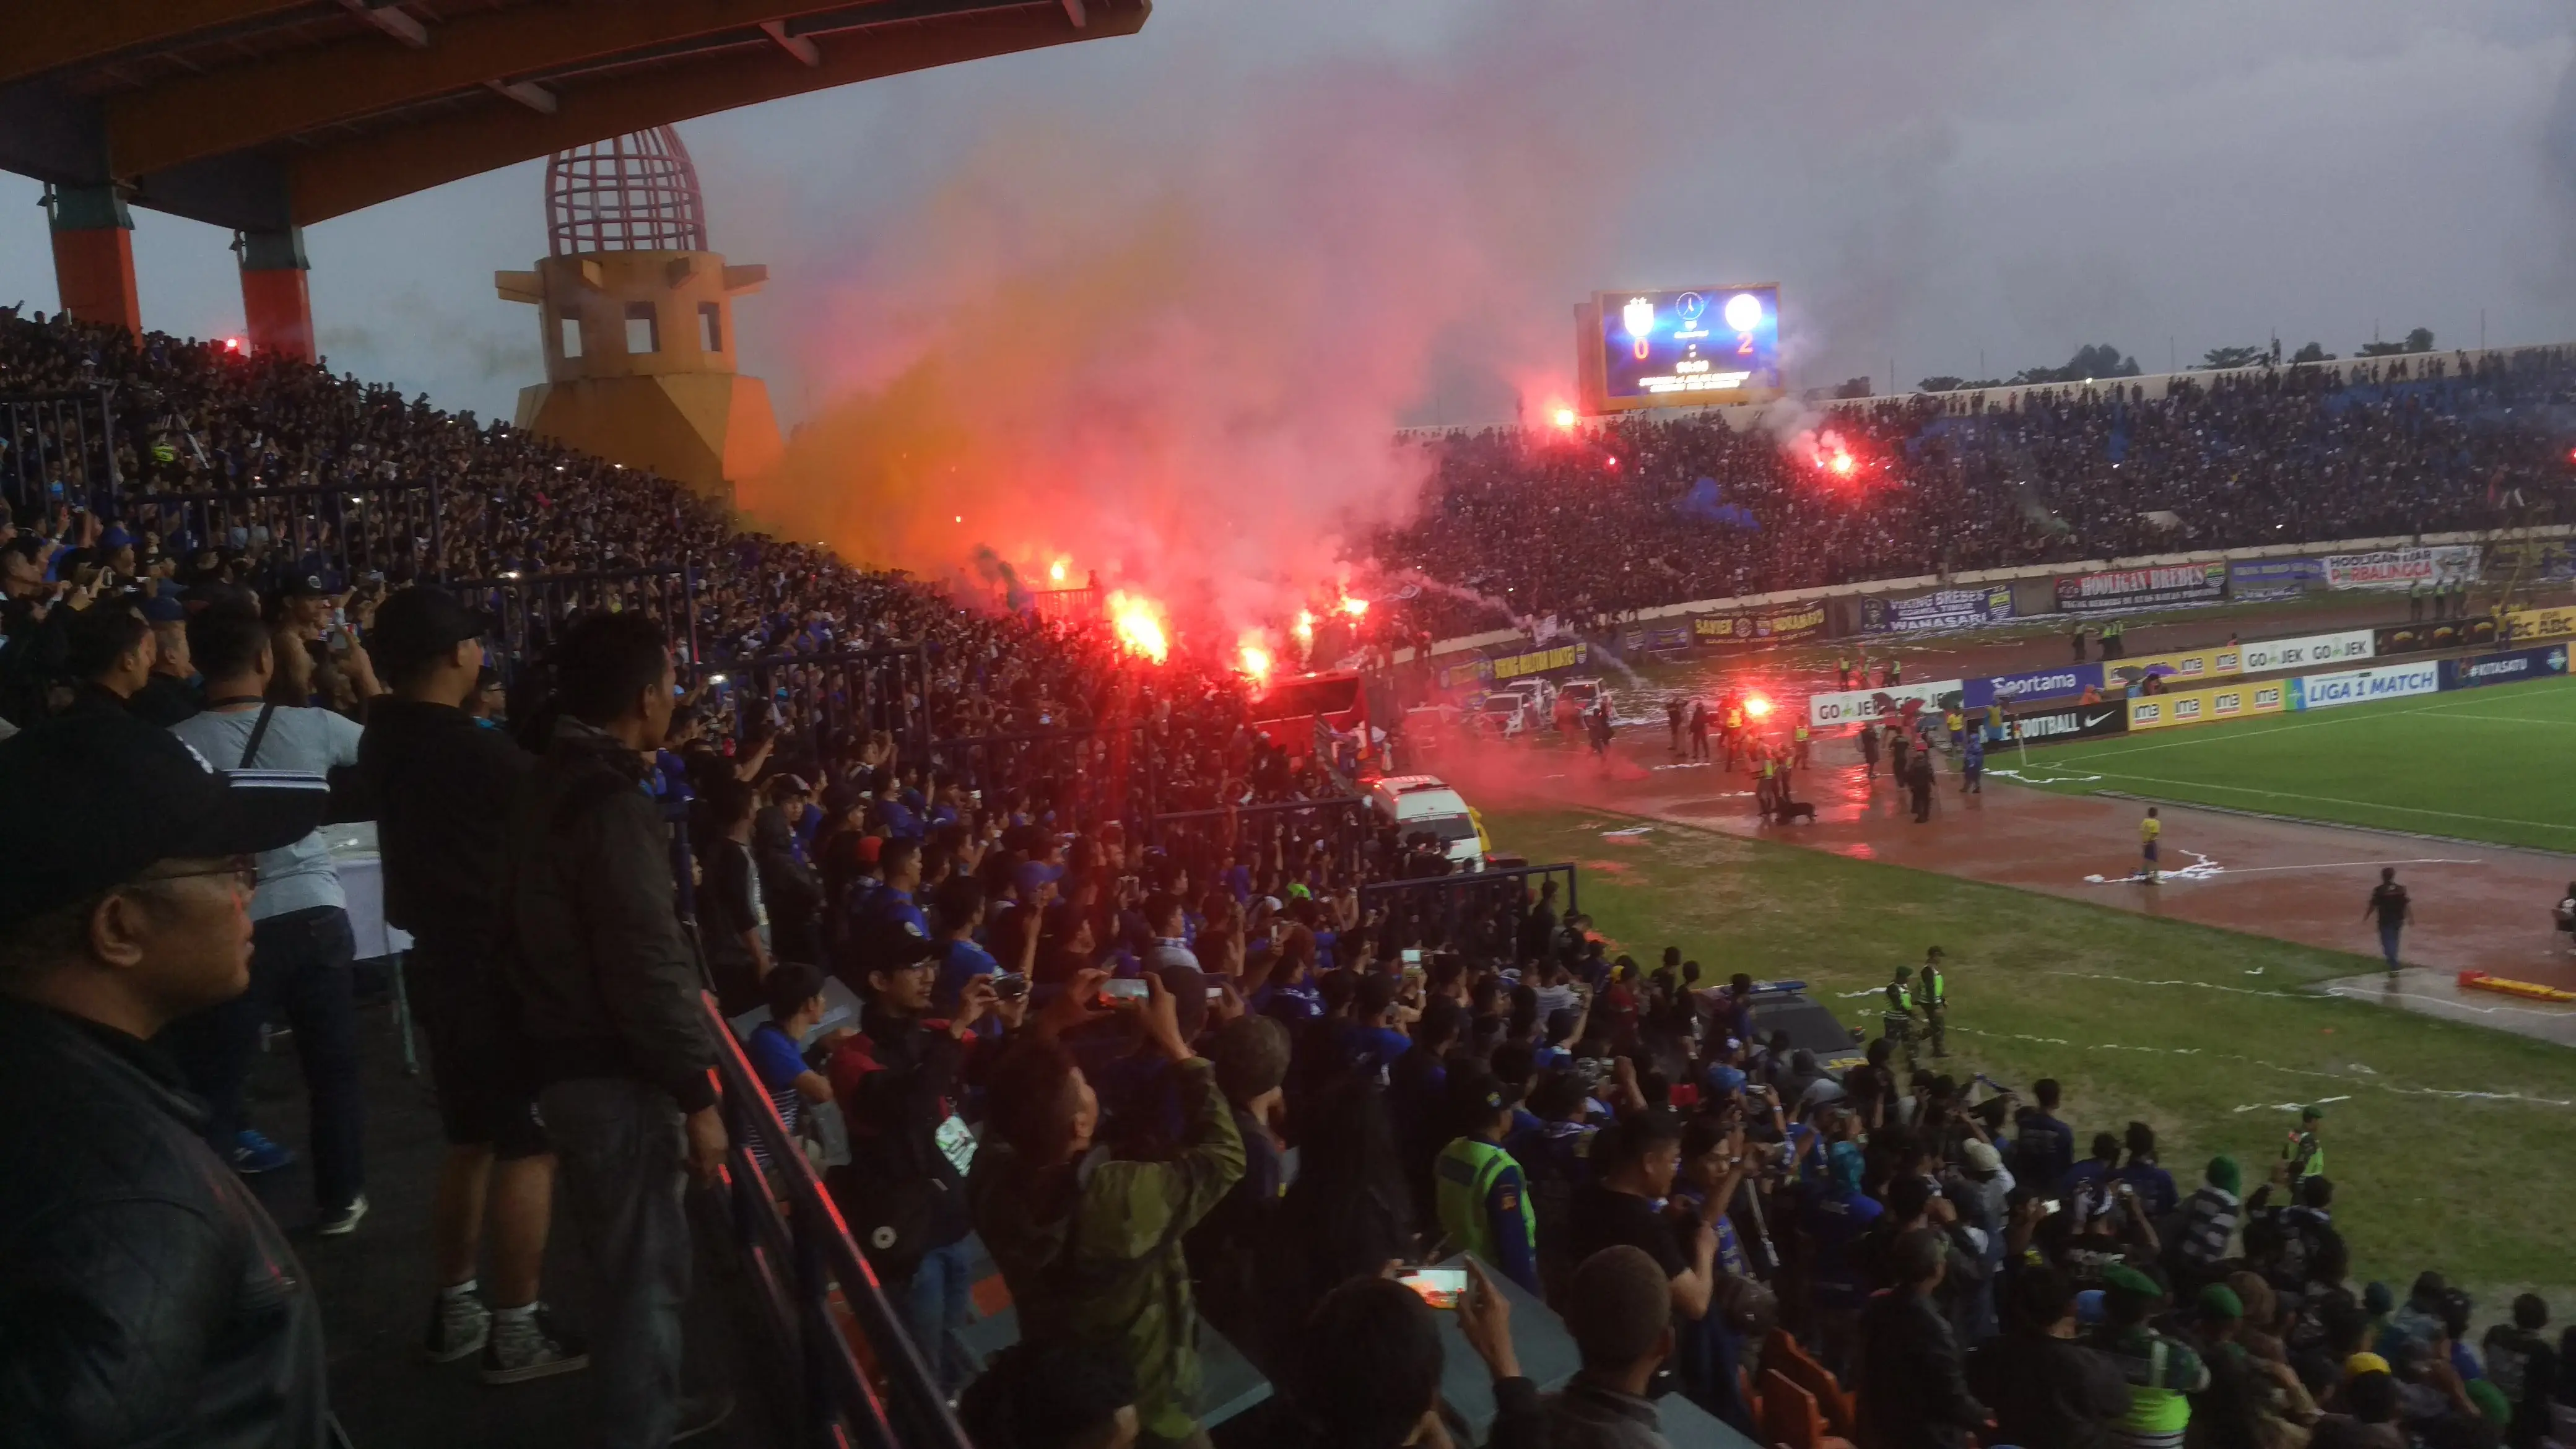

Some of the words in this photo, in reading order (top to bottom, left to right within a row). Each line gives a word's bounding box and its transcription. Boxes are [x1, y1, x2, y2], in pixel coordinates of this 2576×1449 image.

[1635, 337, 1648, 359] 0
[1738, 333, 1753, 354] 2
[2331, 561, 2432, 581] PRBALINGGA
[1890, 612, 1988, 632] WANASARI
[2248, 652, 2267, 668] GO
[2281, 648, 2304, 664] JEK
[2312, 645, 2331, 660] GO
[2344, 640, 2367, 656] JEK
[2310, 681, 2352, 703] LIGA
[2356, 680, 2366, 697] 1
[2370, 672, 2434, 695] MATCH
[1819, 703, 1840, 720] GO
